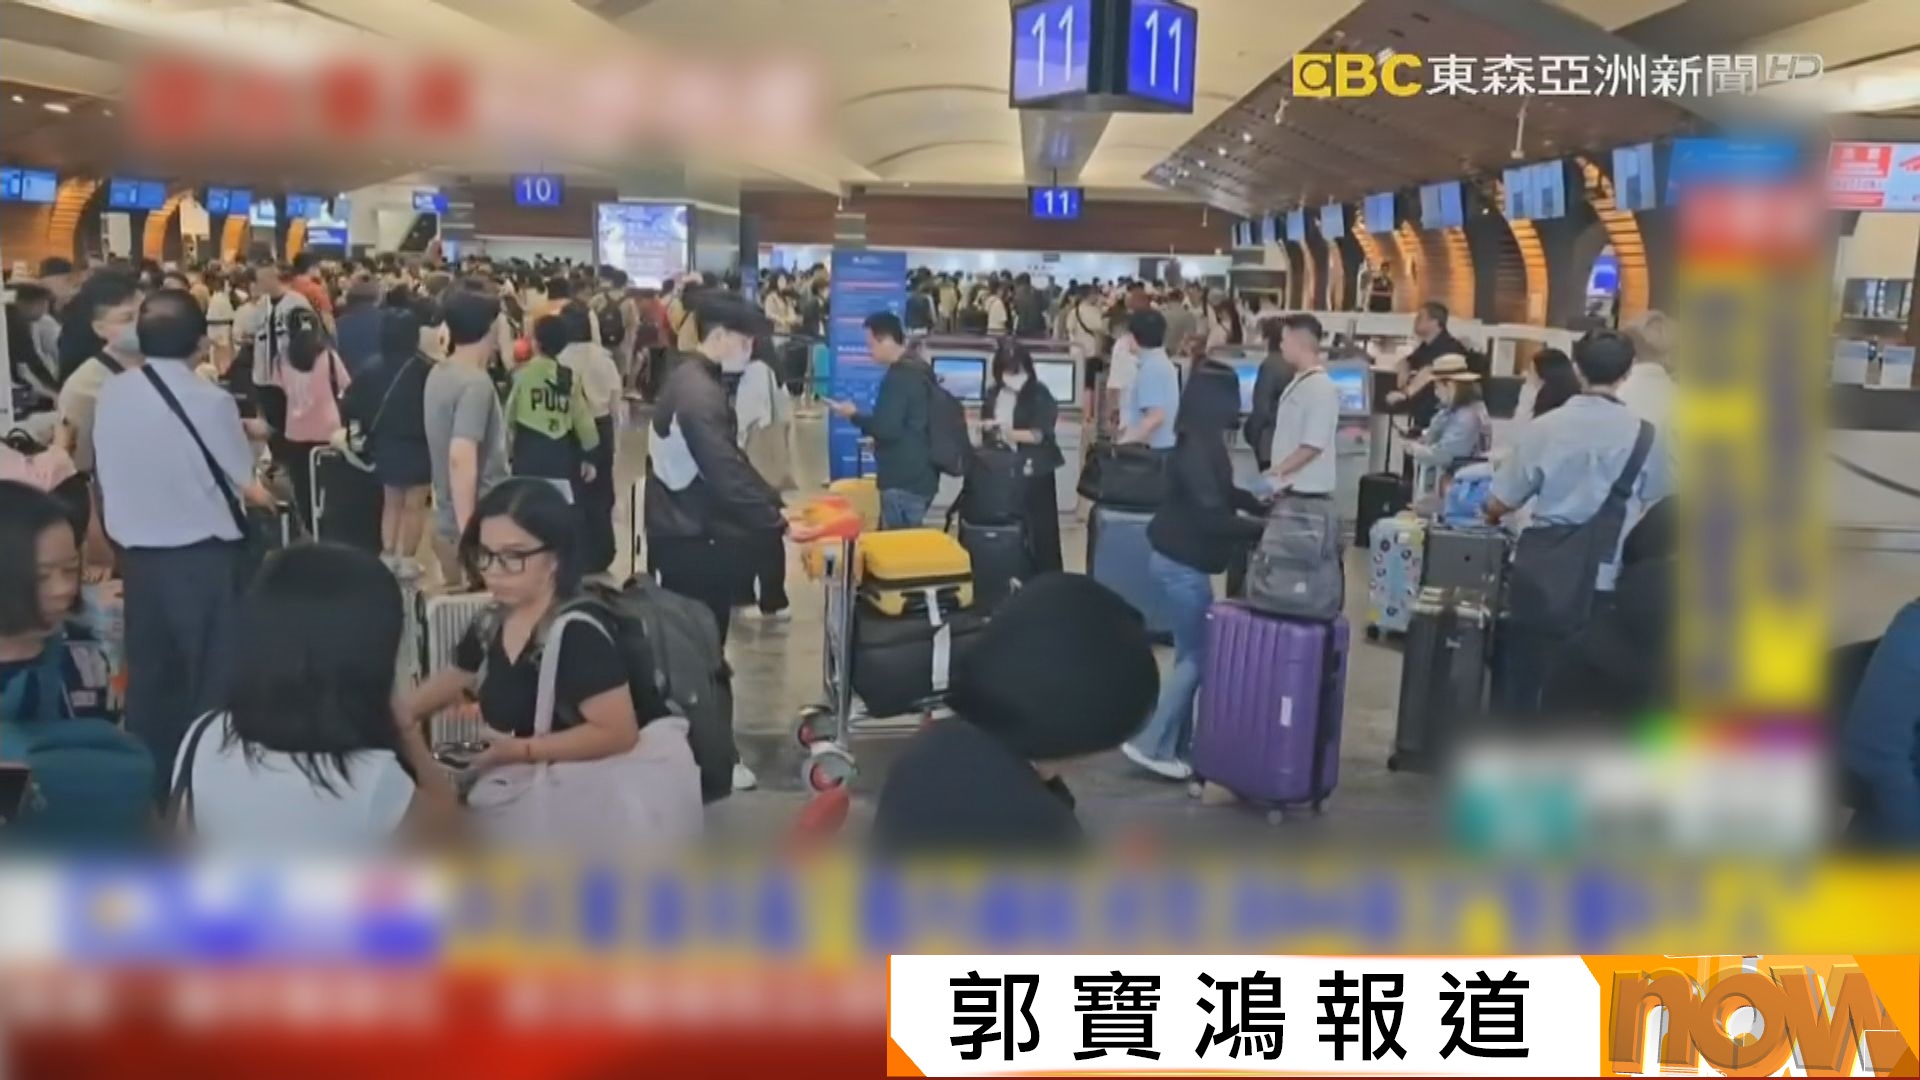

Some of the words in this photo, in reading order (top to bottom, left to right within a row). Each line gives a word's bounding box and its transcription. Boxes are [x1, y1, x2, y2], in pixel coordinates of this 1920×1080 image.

[1031, 5, 1073, 87] 11
[1145, 9, 1182, 95] 11
[522, 177, 551, 201] 10
[1043, 190, 1069, 215] 11
